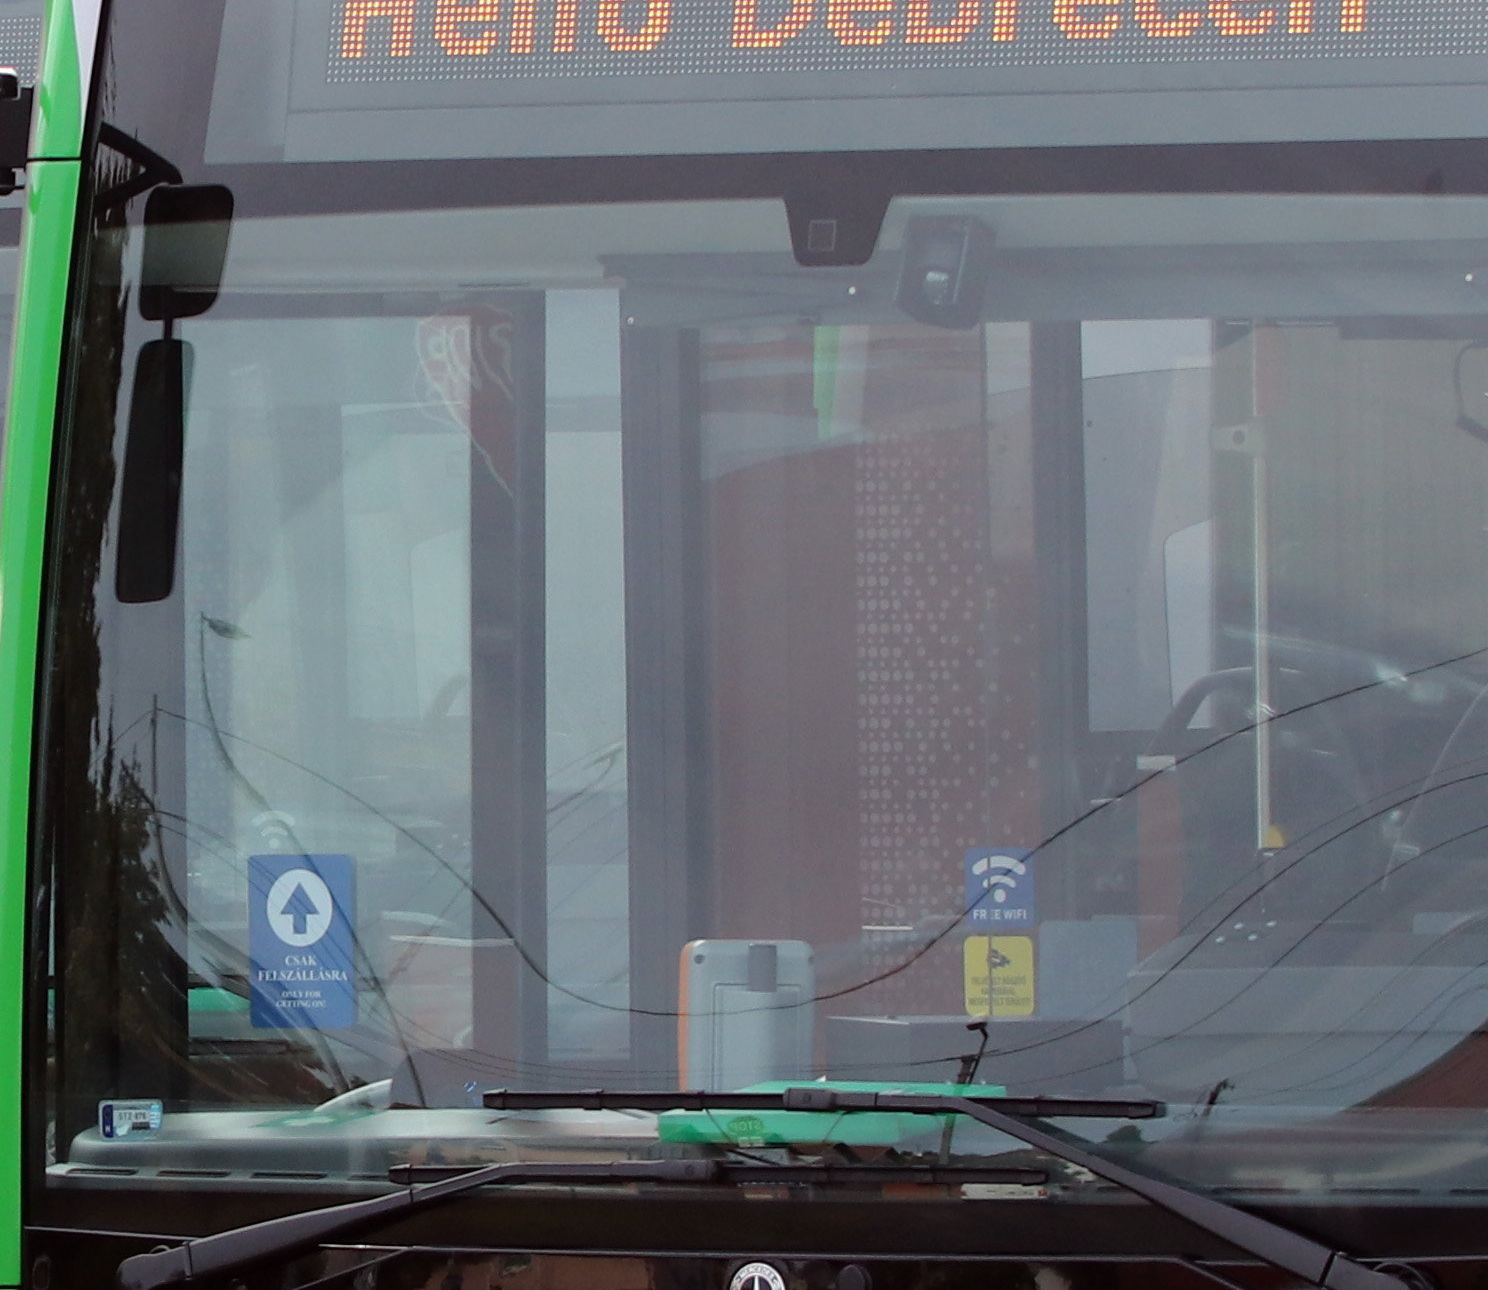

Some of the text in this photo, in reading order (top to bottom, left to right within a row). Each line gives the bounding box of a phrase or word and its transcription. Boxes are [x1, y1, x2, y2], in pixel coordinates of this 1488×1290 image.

[1003, 908, 1027, 920] WIFI
[284, 954, 318, 967] CSAK
[257, 966, 349, 982] FELSZÁLLÁSRA
[281, 989, 322, 999] ONLY FOR
